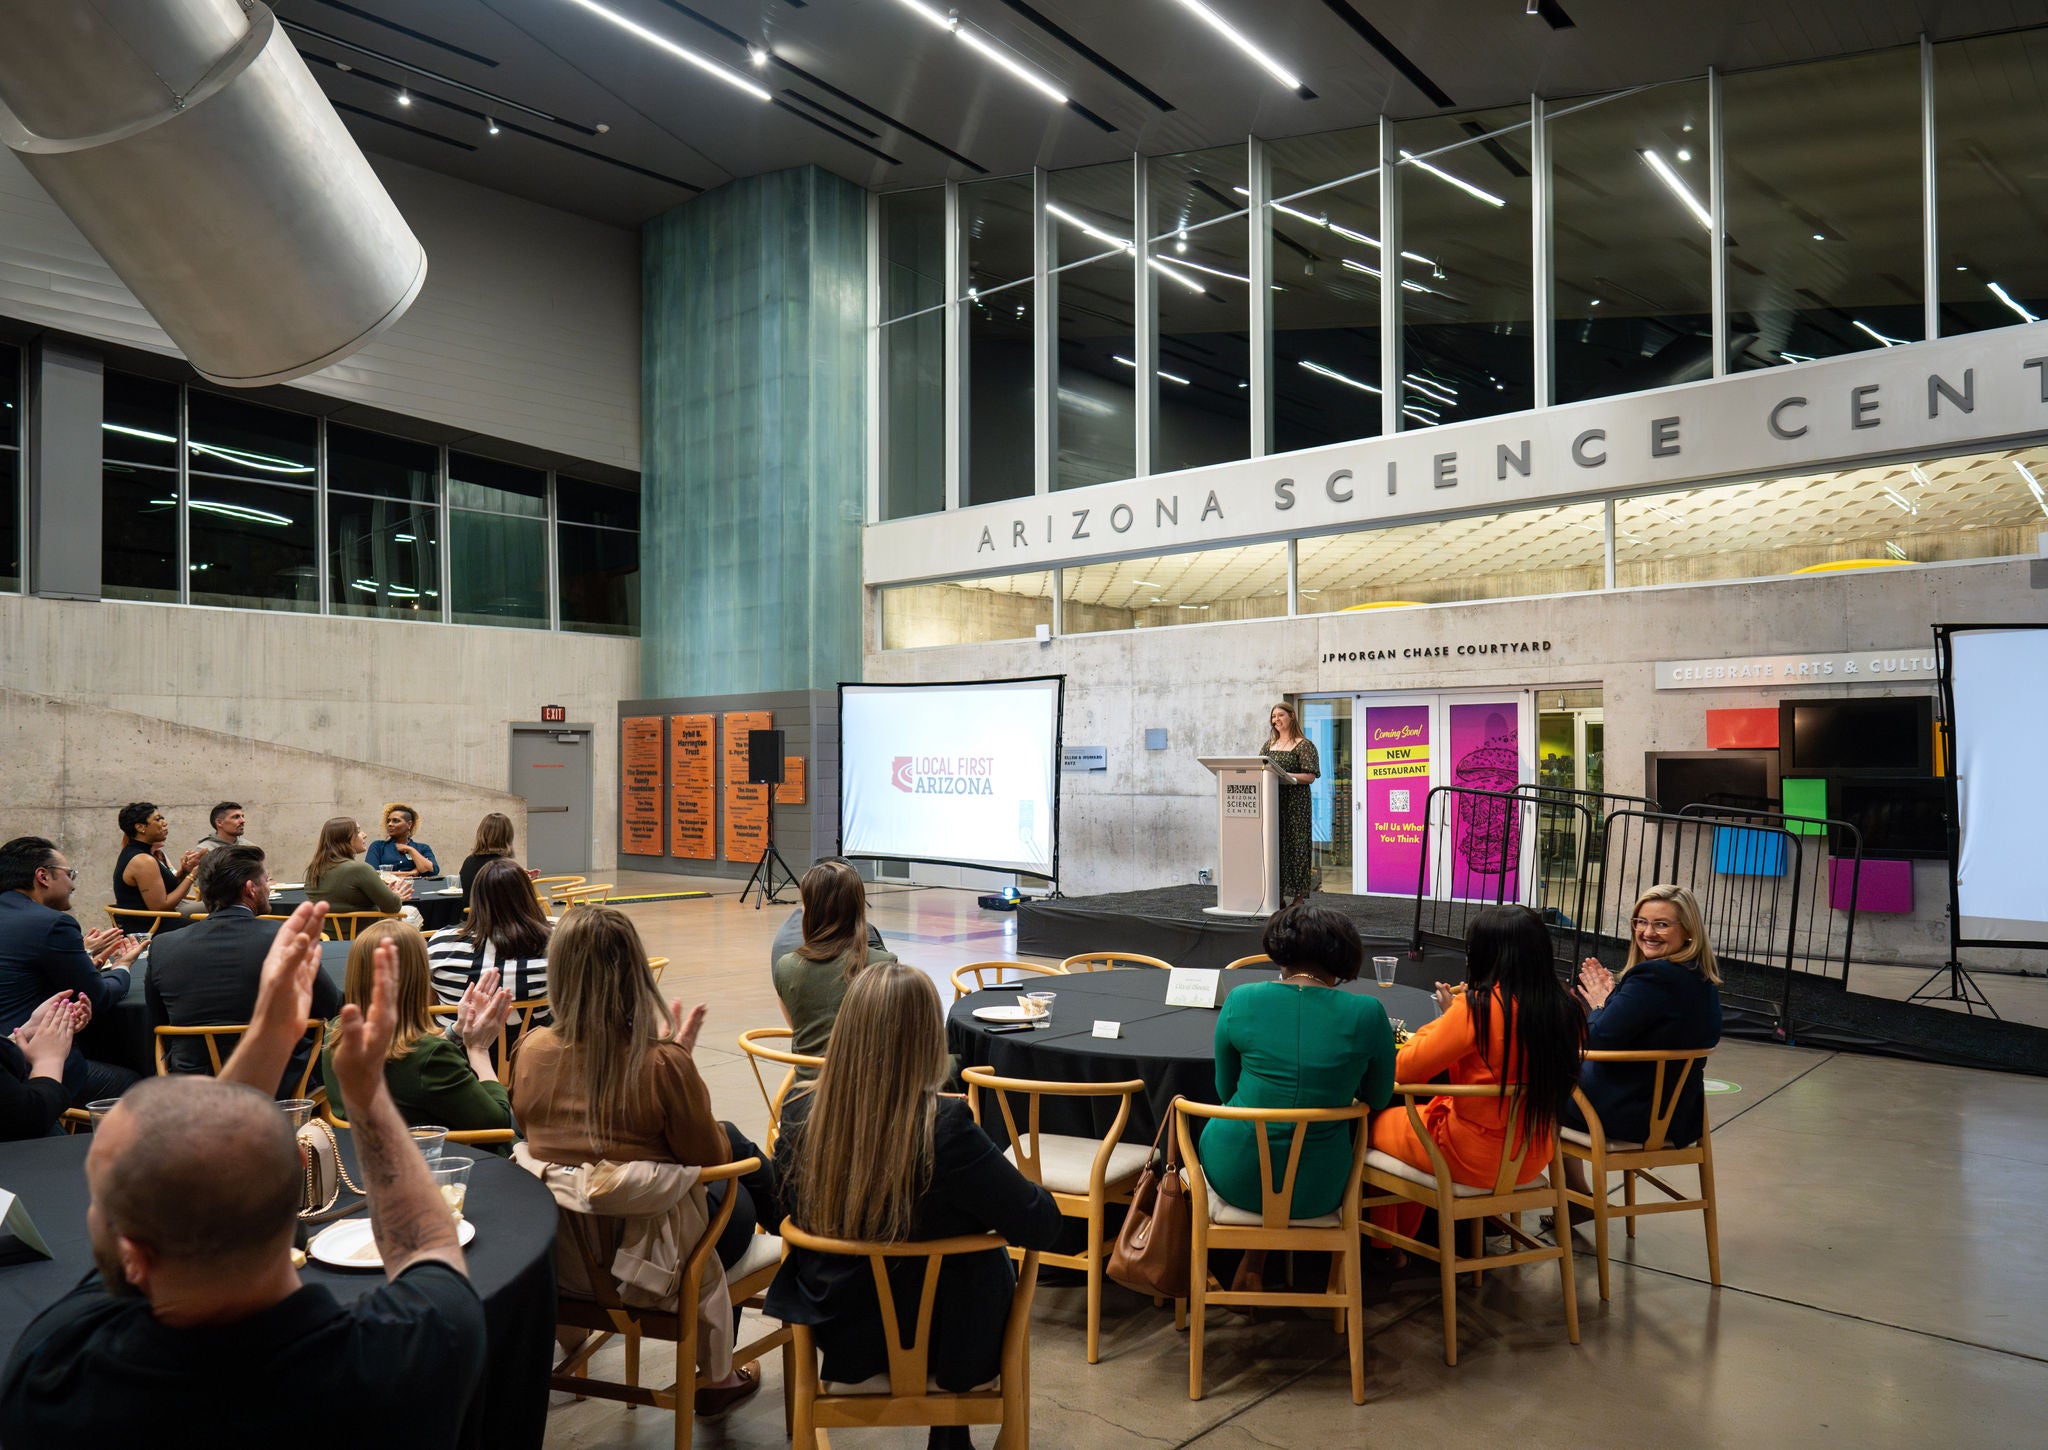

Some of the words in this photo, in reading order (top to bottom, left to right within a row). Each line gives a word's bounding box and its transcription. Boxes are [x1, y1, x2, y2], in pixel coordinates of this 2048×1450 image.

[977, 489, 1224, 553] ARIZONA
[1274, 415, 1681, 511] SCIENCE
[1322, 649, 1396, 663] JPMORGAN
[1403, 646, 1449, 658] CHASE
[1457, 641, 1551, 655] COURTYARD
[1672, 663, 1773, 681] CELEBRATE
[1783, 661, 1834, 676] ARTS
[1844, 660, 1859, 674] &
[1869, 656, 1945, 673] CULTU
[546, 708, 562, 720] EXIT
[1374, 727, 1401, 741] Coming
[1386, 749, 1411, 759] NEW
[916, 756, 954, 776] LOCAL
[958, 757, 994, 777] FIRST
[1373, 765, 1426, 776] RESTAURANT
[915, 777, 994, 795] ARIZONA
[1374, 822, 1389, 831] Tell
[1390, 822, 1401, 831] Us
[1380, 834, 1396, 843] You
[1397, 834, 1420, 843] Think
